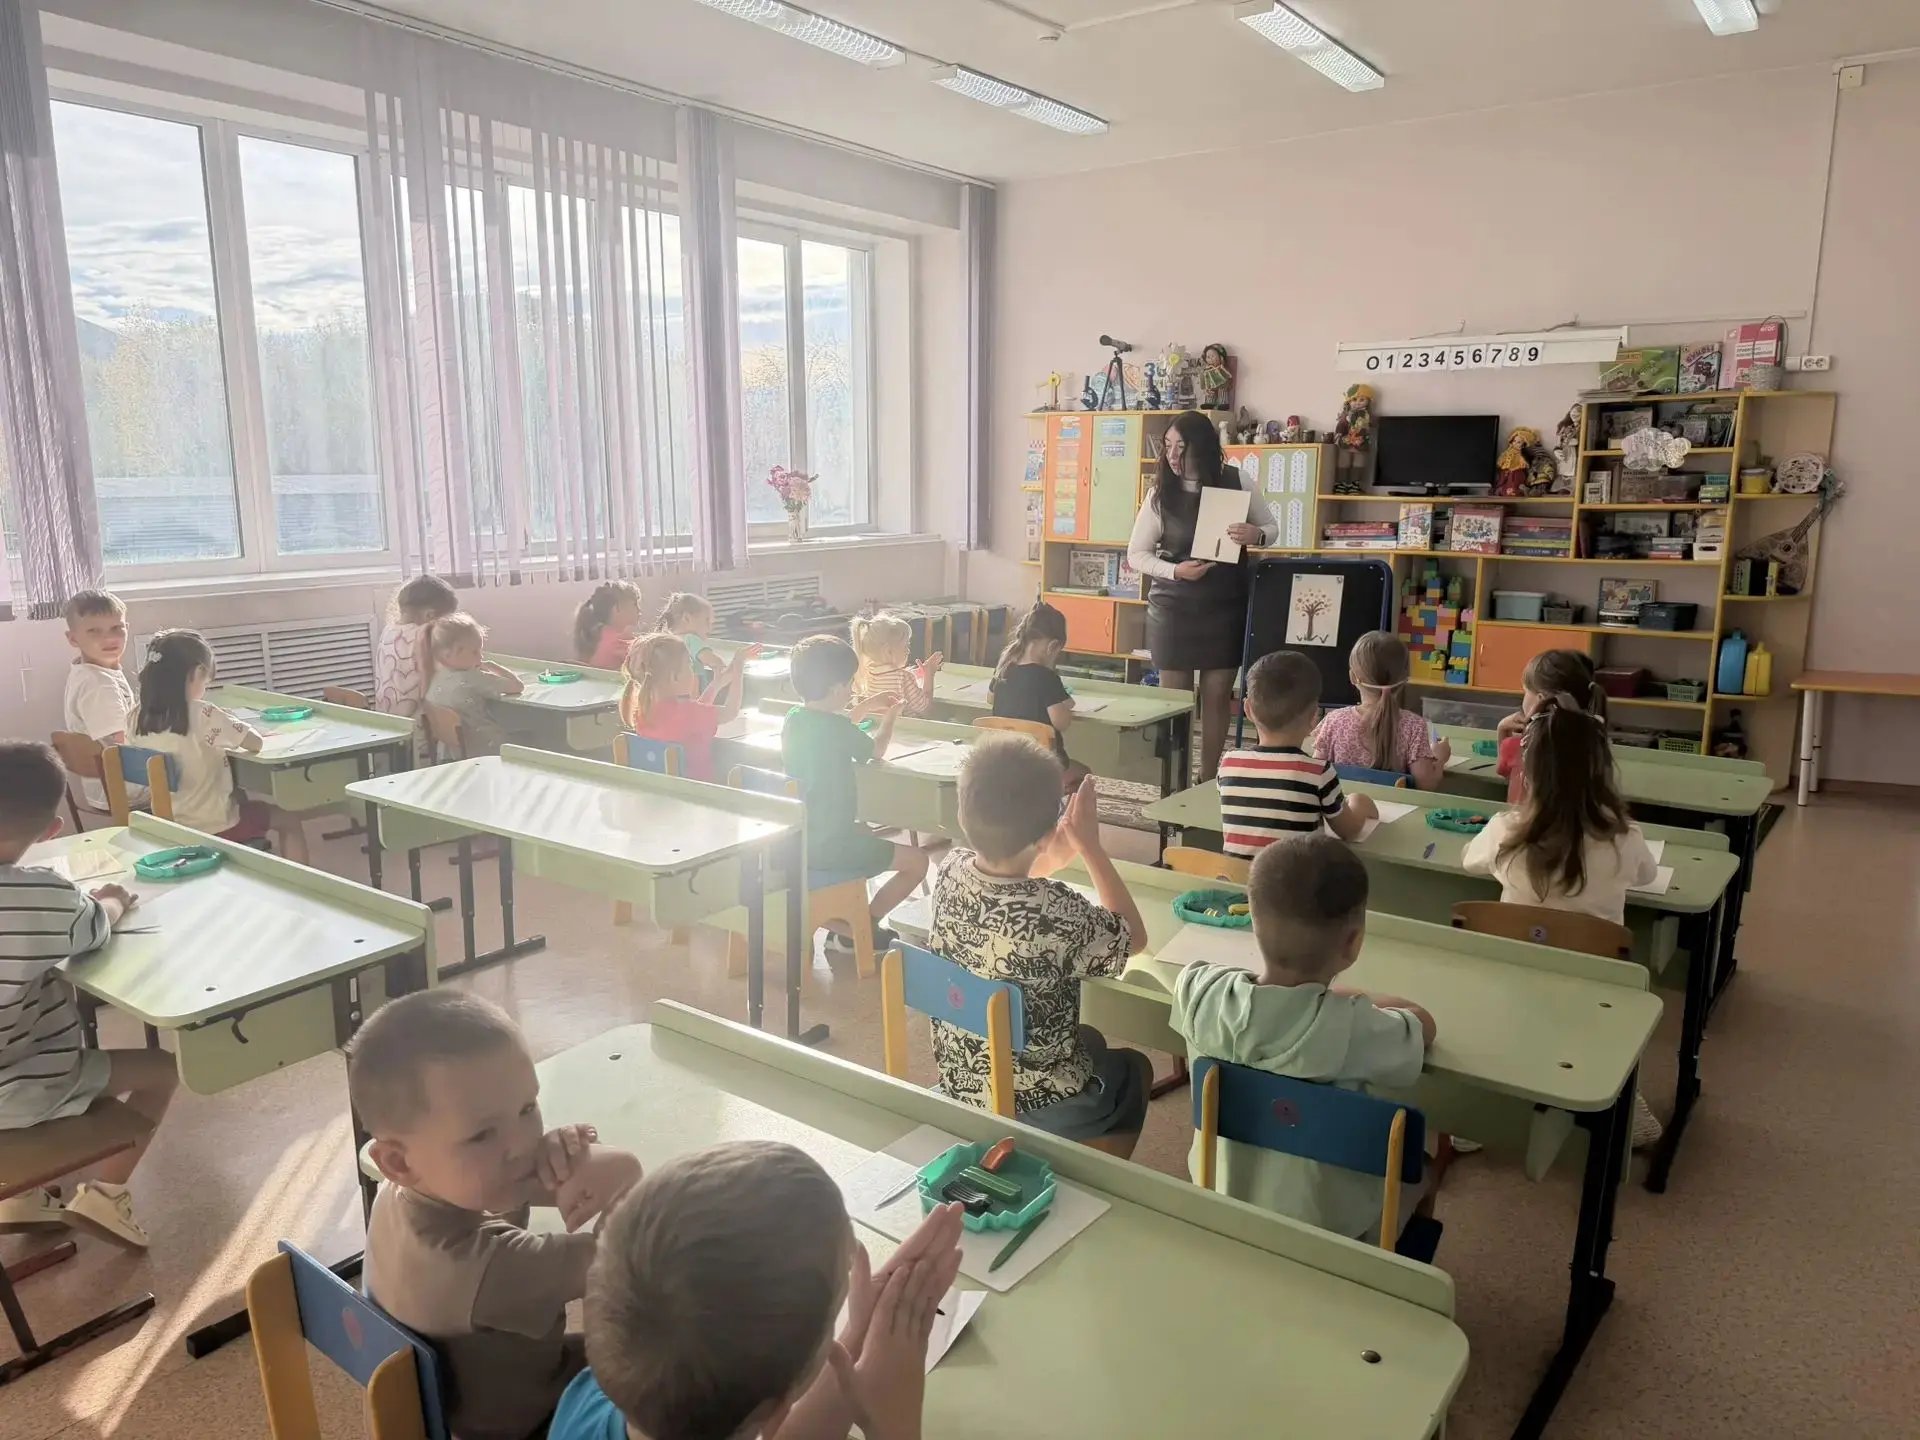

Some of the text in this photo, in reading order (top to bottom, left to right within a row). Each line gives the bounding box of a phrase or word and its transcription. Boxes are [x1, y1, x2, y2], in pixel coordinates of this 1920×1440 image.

[1366, 347, 1539, 370] 0 1 2 3 4 5 6 7 8 9
[1534, 928, 1542, 938] 2
